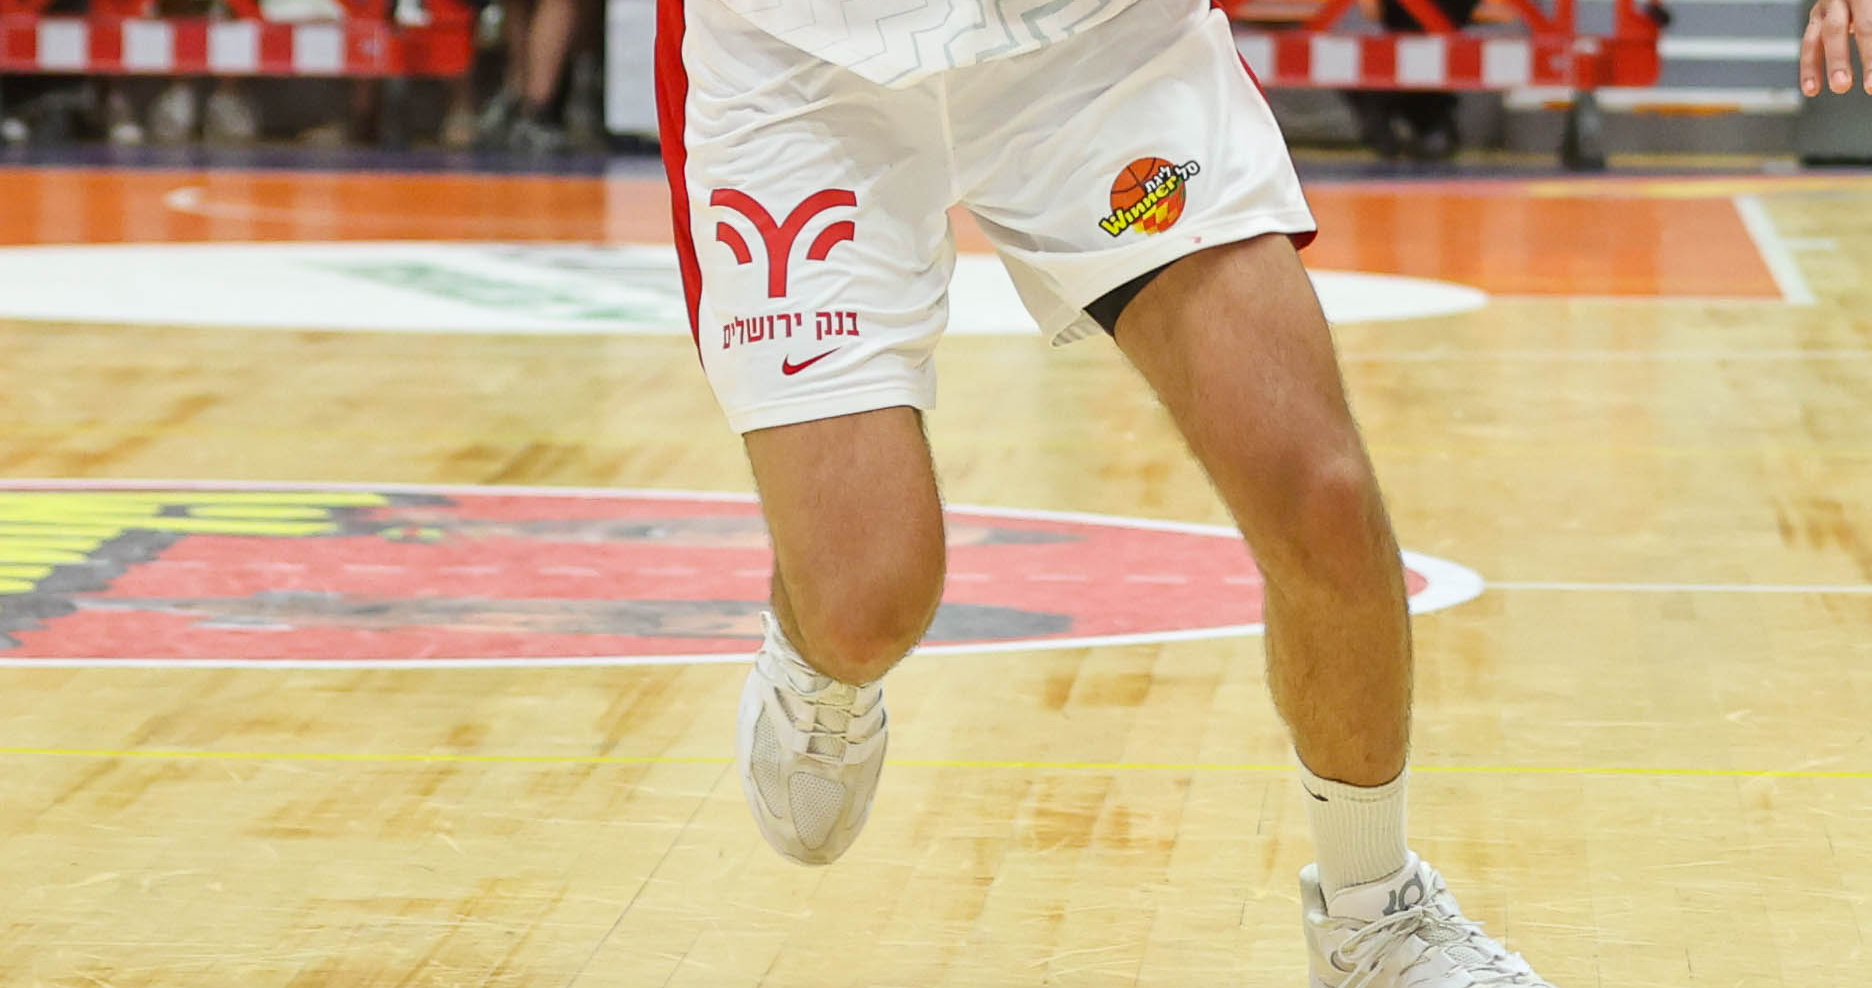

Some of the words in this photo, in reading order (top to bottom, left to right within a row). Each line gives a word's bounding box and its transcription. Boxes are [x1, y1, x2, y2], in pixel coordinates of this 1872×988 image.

[1100, 175, 1178, 235] Winner
[723, 313, 802, 349] ירושלים
[816, 312, 860, 340] בנק
